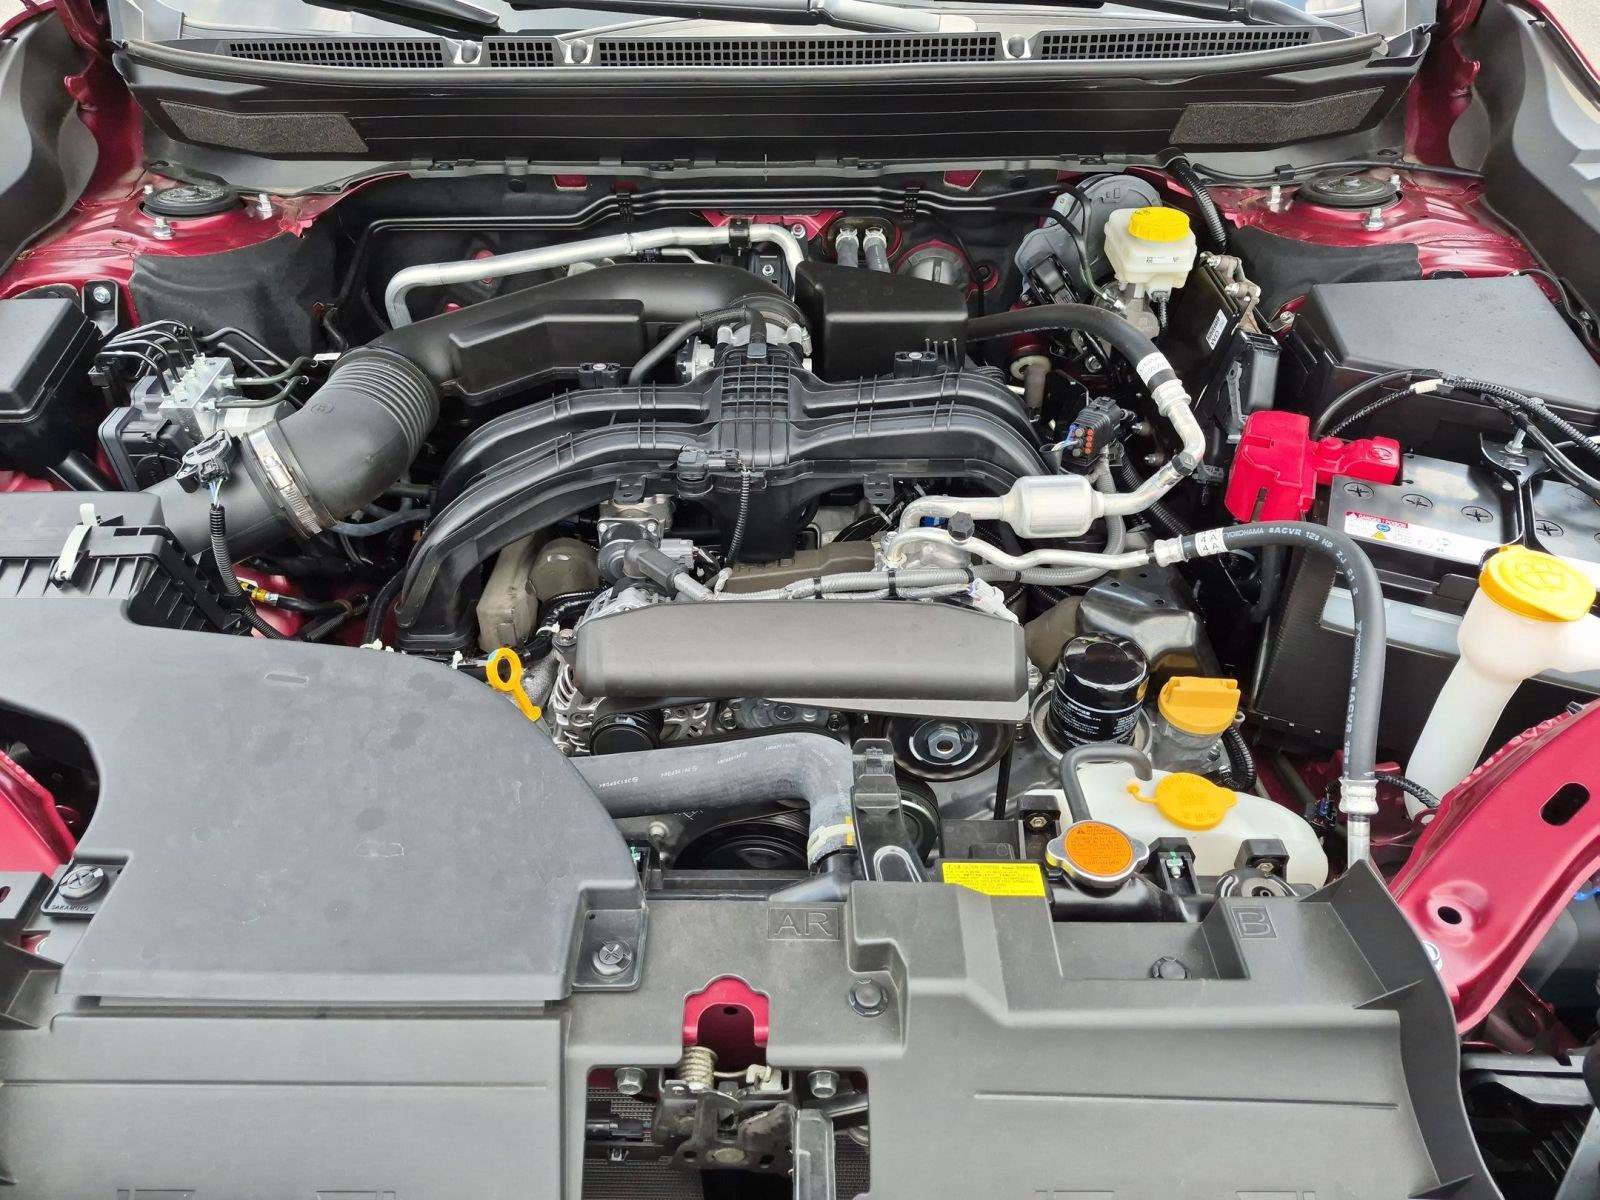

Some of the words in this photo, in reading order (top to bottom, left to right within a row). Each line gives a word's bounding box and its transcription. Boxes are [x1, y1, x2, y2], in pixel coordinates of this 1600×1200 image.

[1225, 527, 1264, 538] YOKOHAMA
[1352, 631, 1362, 680] YOKOHAMA
[774, 911, 832, 936] AR
[1239, 911, 1271, 936] B
